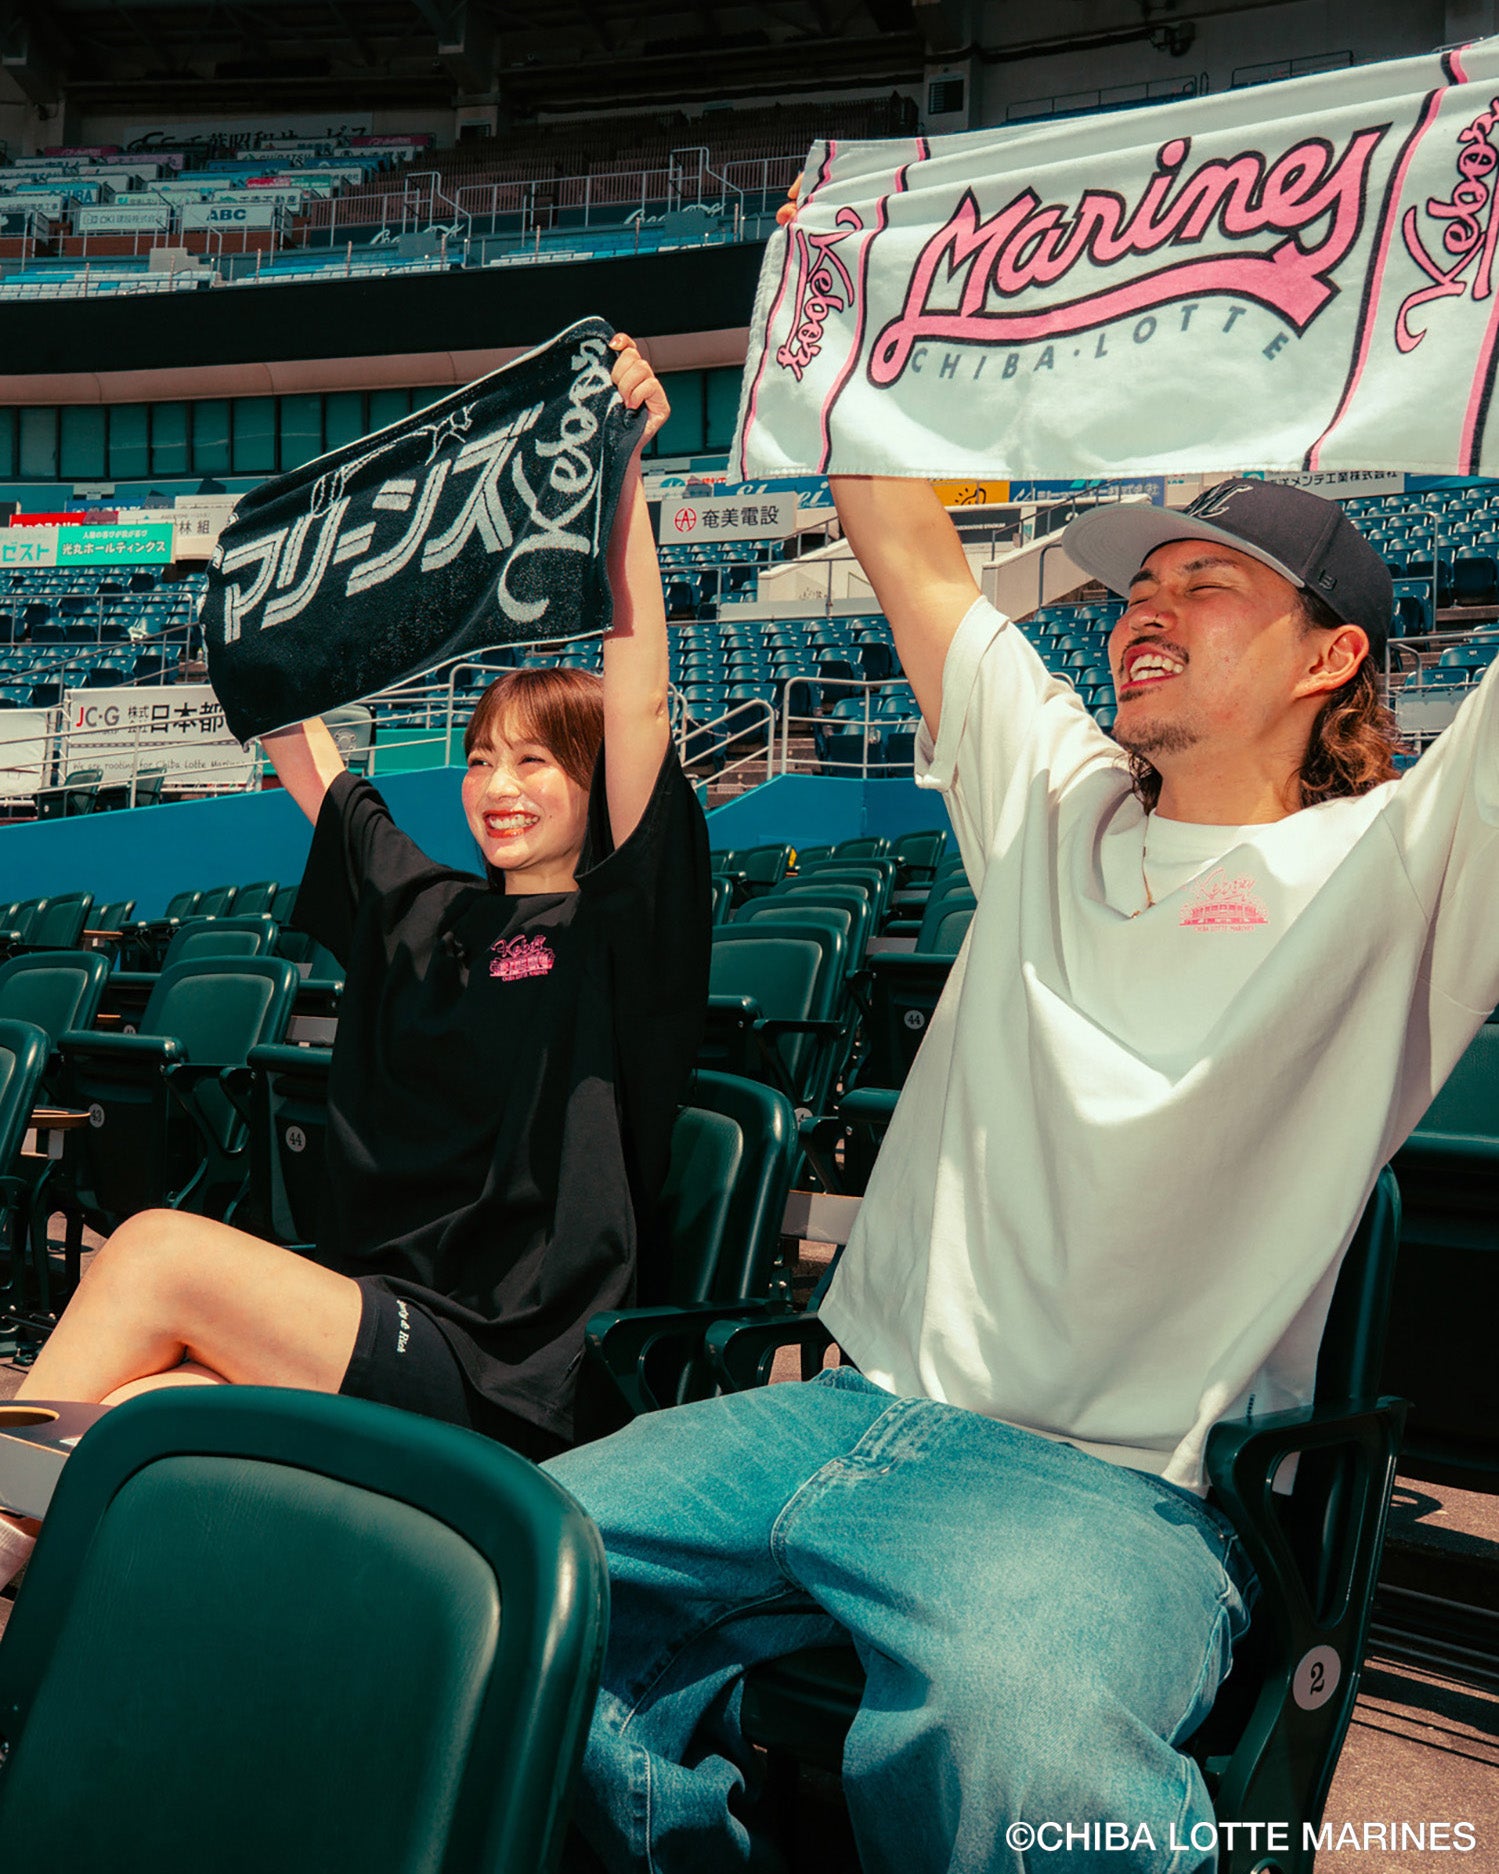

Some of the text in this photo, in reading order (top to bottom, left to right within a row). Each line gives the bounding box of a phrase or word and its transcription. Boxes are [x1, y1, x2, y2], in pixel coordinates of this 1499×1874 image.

[206, 208, 247, 221] ABC
[868, 122, 1393, 389] Marines
[221, 401, 545, 645] マリーンズ
[702, 505, 779, 529] 奄美電設
[62, 539, 167, 556] 光丸ホールディングス
[907, 1014, 921, 1025] 44
[289, 1132, 303, 1146] 44
[1310, 1661, 1325, 1695] 2
